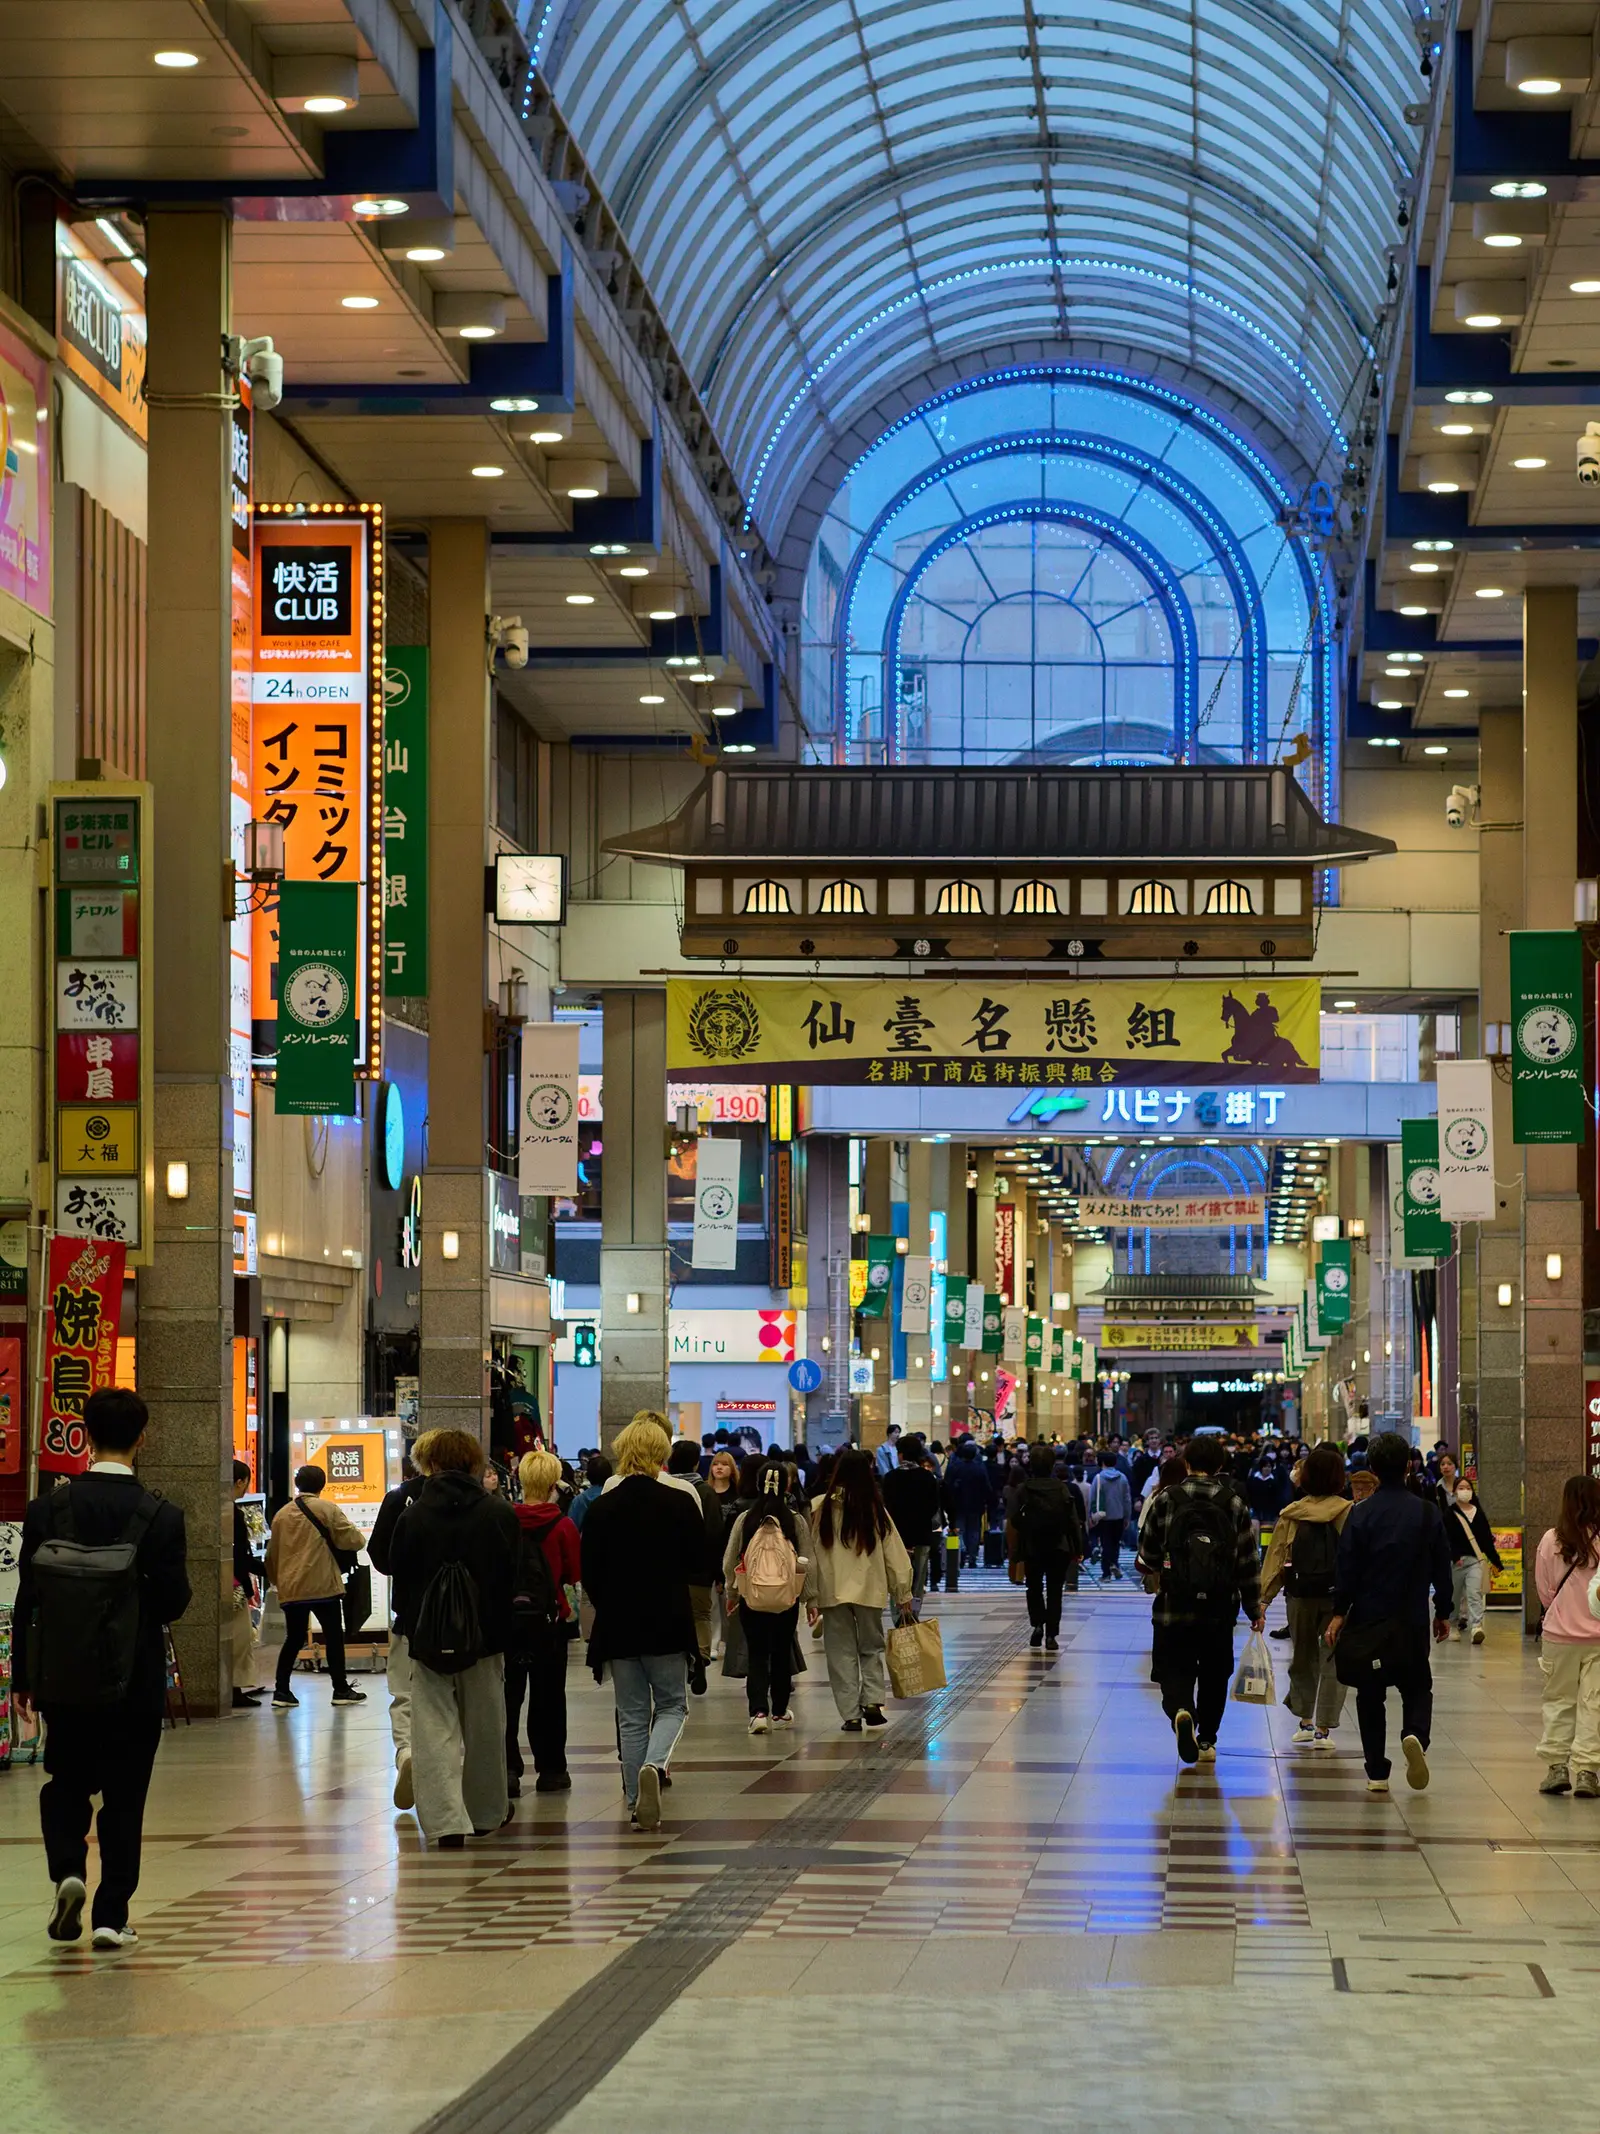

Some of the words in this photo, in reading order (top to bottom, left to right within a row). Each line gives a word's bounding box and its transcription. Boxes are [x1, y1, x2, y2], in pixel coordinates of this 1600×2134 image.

[272, 561, 339, 594] 快活
[274, 598, 339, 621] CLUB
[306, 686, 349, 698] OPEN
[312, 724, 350, 880] コミック
[82, 834, 114, 850] ビル
[500, 884, 506, 892] 9
[75, 905, 119, 919] チロル
[800, 996, 1181, 1055] 仙臺名懸組
[85, 1034, 114, 1099] 串屋
[864, 1060, 1120, 1083] 名掛丁商店街振興組合
[670, 1089, 714, 1097] ハイボール
[715, 1096, 759, 1118] 190
[1102, 1088, 1286, 1125] ハピナ名掛丁
[77, 1143, 119, 1162] 大福
[51, 1283, 103, 1417] 焼鳥
[675, 1336, 725, 1353] Miru
[331, 1450, 360, 1466] 快活
[332, 1467, 360, 1477] CLUB
